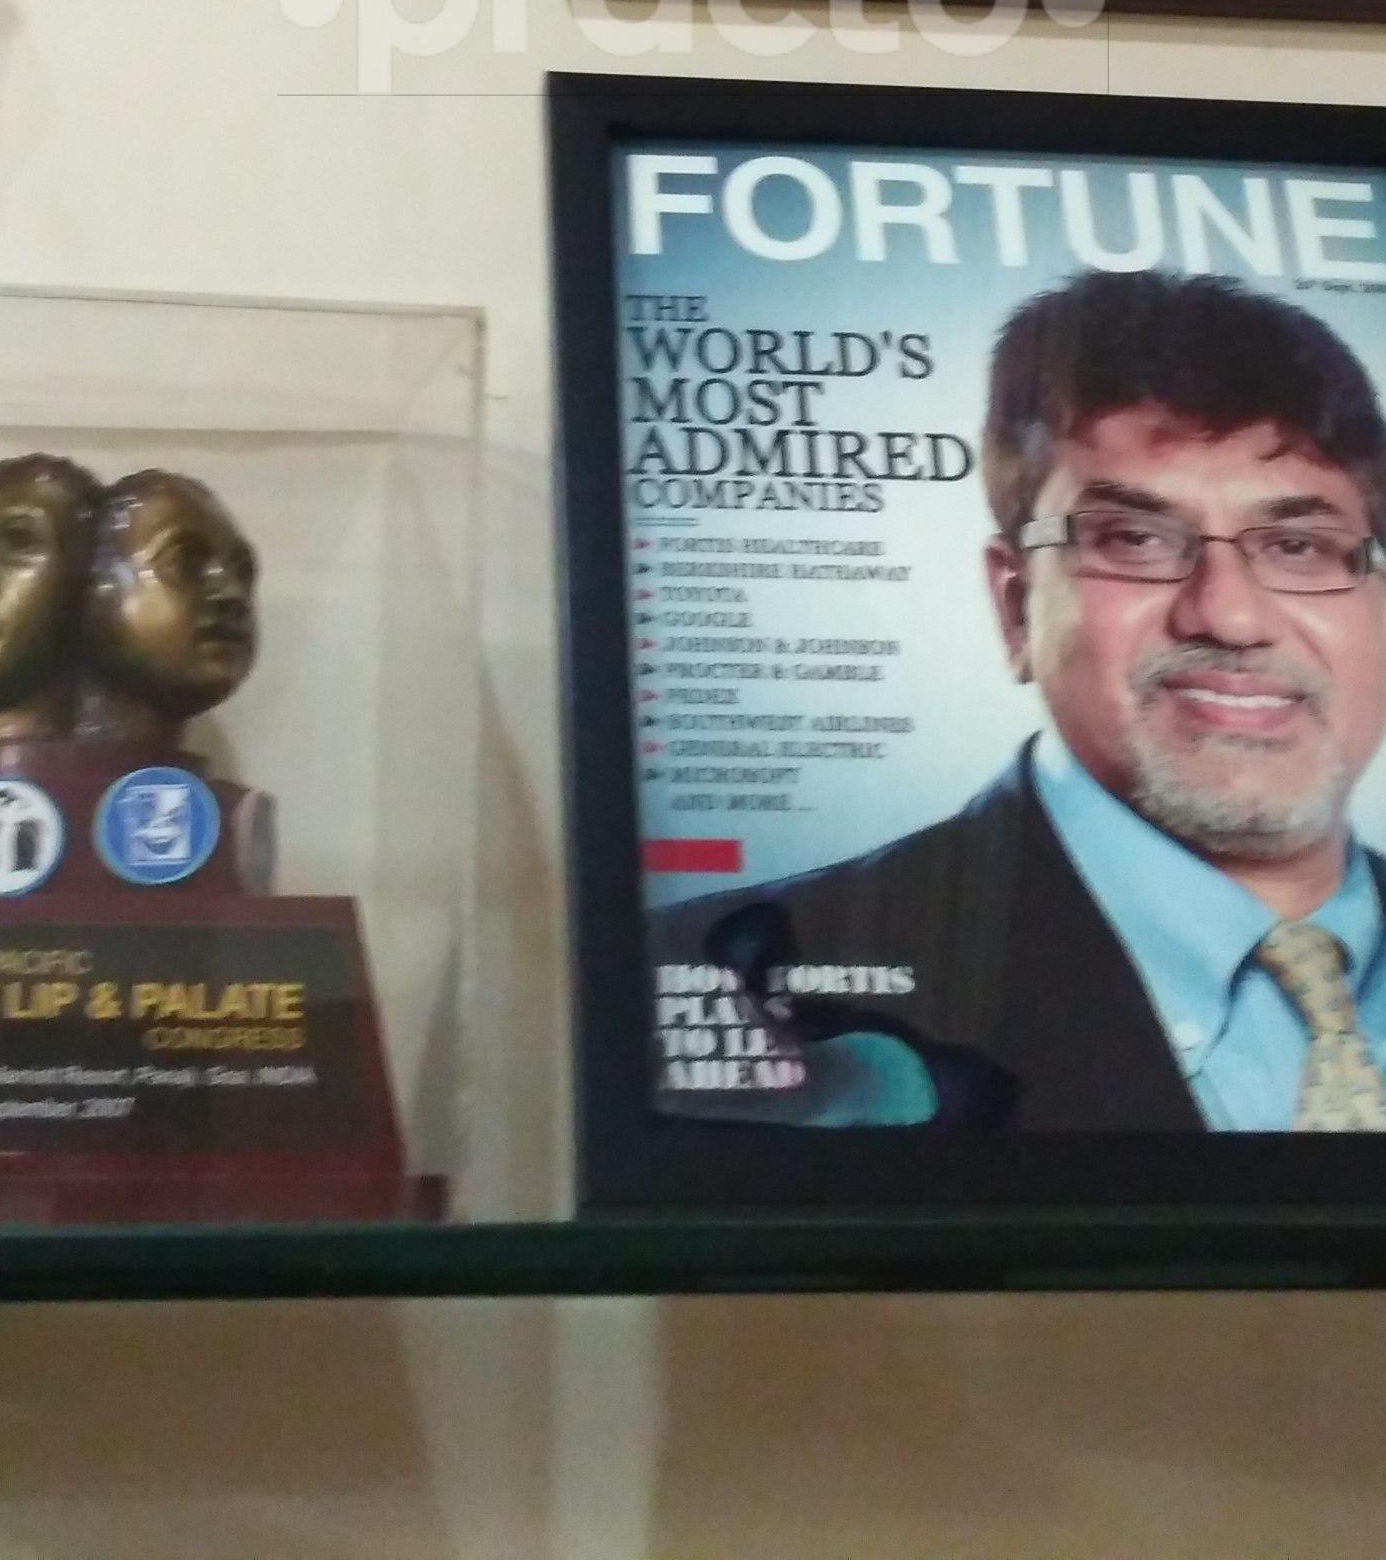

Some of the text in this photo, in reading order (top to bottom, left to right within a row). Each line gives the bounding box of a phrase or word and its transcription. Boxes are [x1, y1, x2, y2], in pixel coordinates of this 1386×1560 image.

[625, 294, 709, 322] THE
[626, 326, 934, 380] WORLD'S
[626, 377, 825, 427] MOST
[626, 425, 975, 482] ADMIRED
[634, 478, 887, 513] COMPANIES
[742, 537, 885, 556] HEALTHCARE
[792, 563, 912, 581] HATHAWAY
[661, 586, 748, 603] TOYOTA
[663, 611, 753, 628] GOOGLE
[663, 636, 771, 653] JOHNSON
[794, 638, 902, 656] JOHNSON
[665, 662, 762, 679] PROCTER
[794, 664, 886, 682] GAMBLE
[670, 766, 802, 784] MICROSOFT
[2, 980, 80, 1020] LIP
[84, 980, 123, 1021] &
[132, 981, 305, 1020] PALATE
